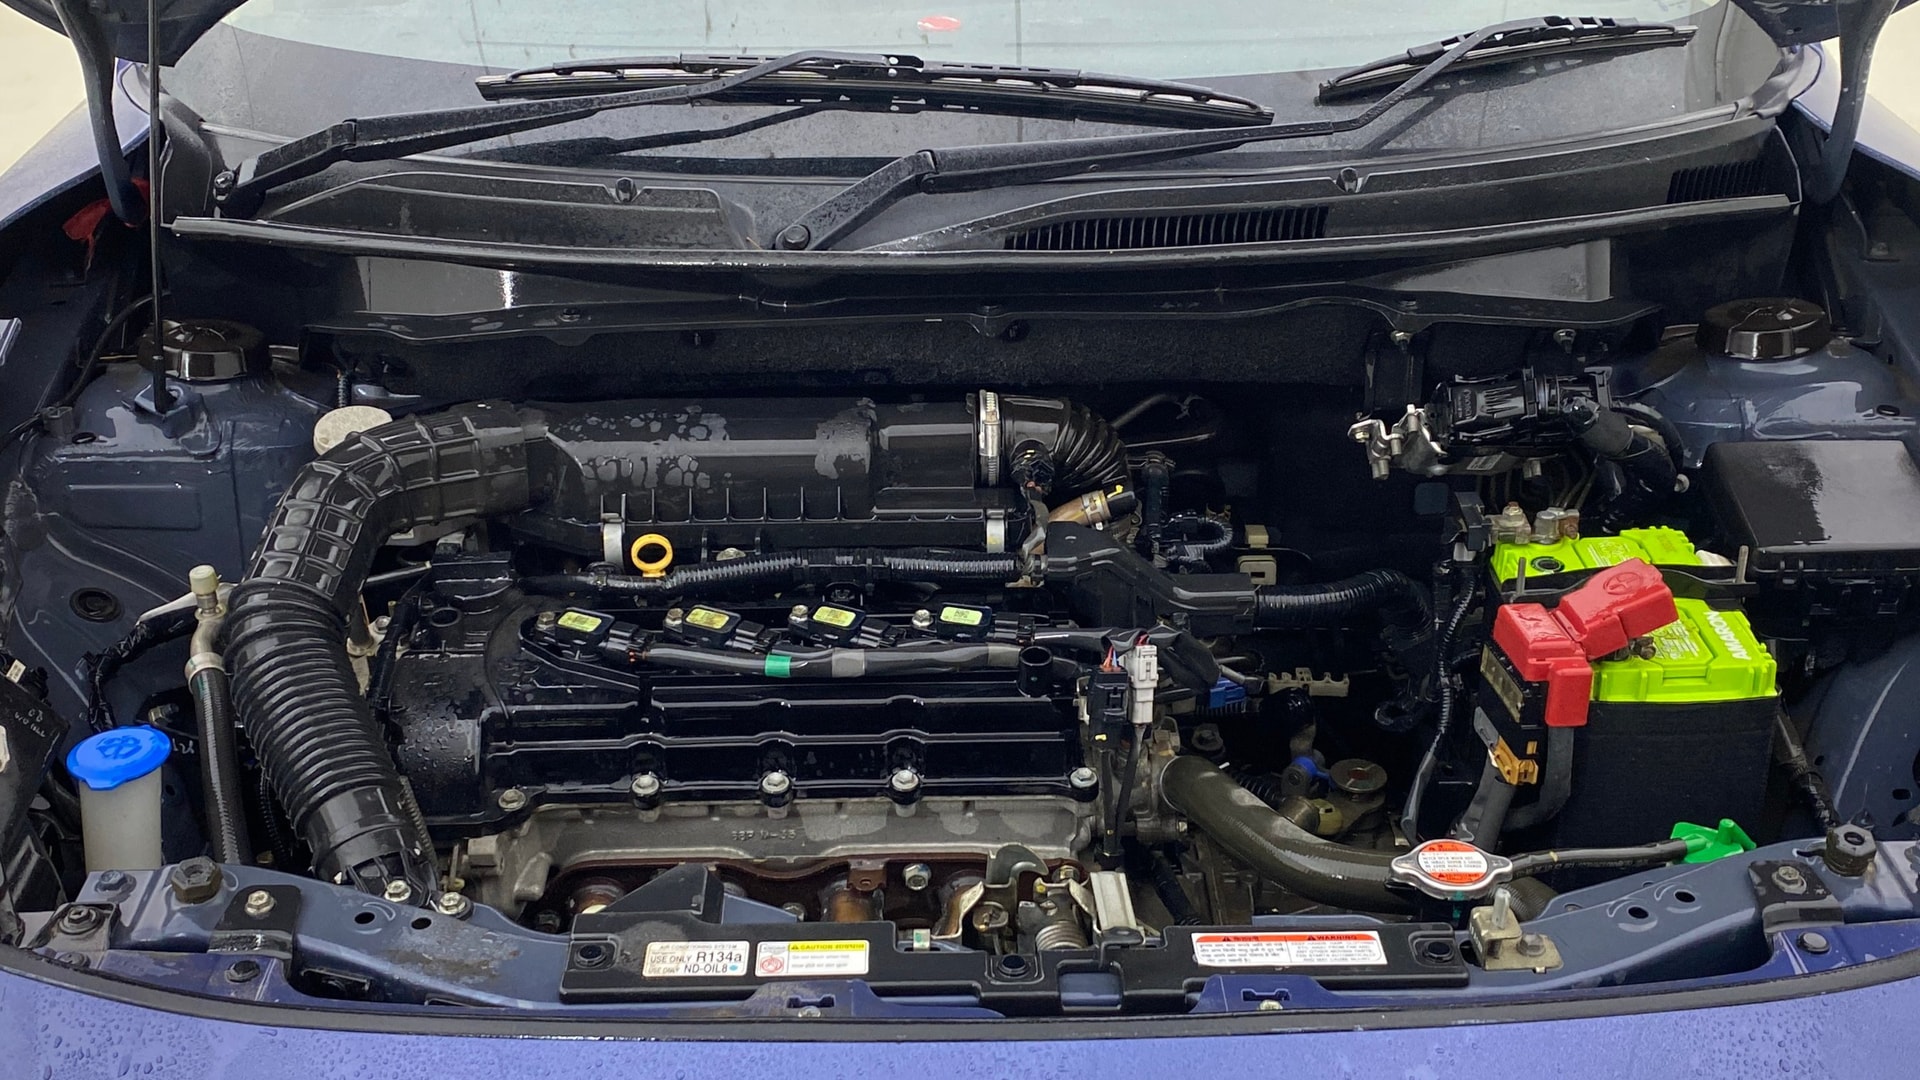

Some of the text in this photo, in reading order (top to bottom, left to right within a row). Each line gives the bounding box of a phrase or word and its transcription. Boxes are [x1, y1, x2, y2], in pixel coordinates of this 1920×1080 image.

[1703, 611, 1752, 660] AMARON
[650, 951, 742, 963] USE ONLY R134a
[648, 963, 728, 974] USE ONLY ND-OIL8
